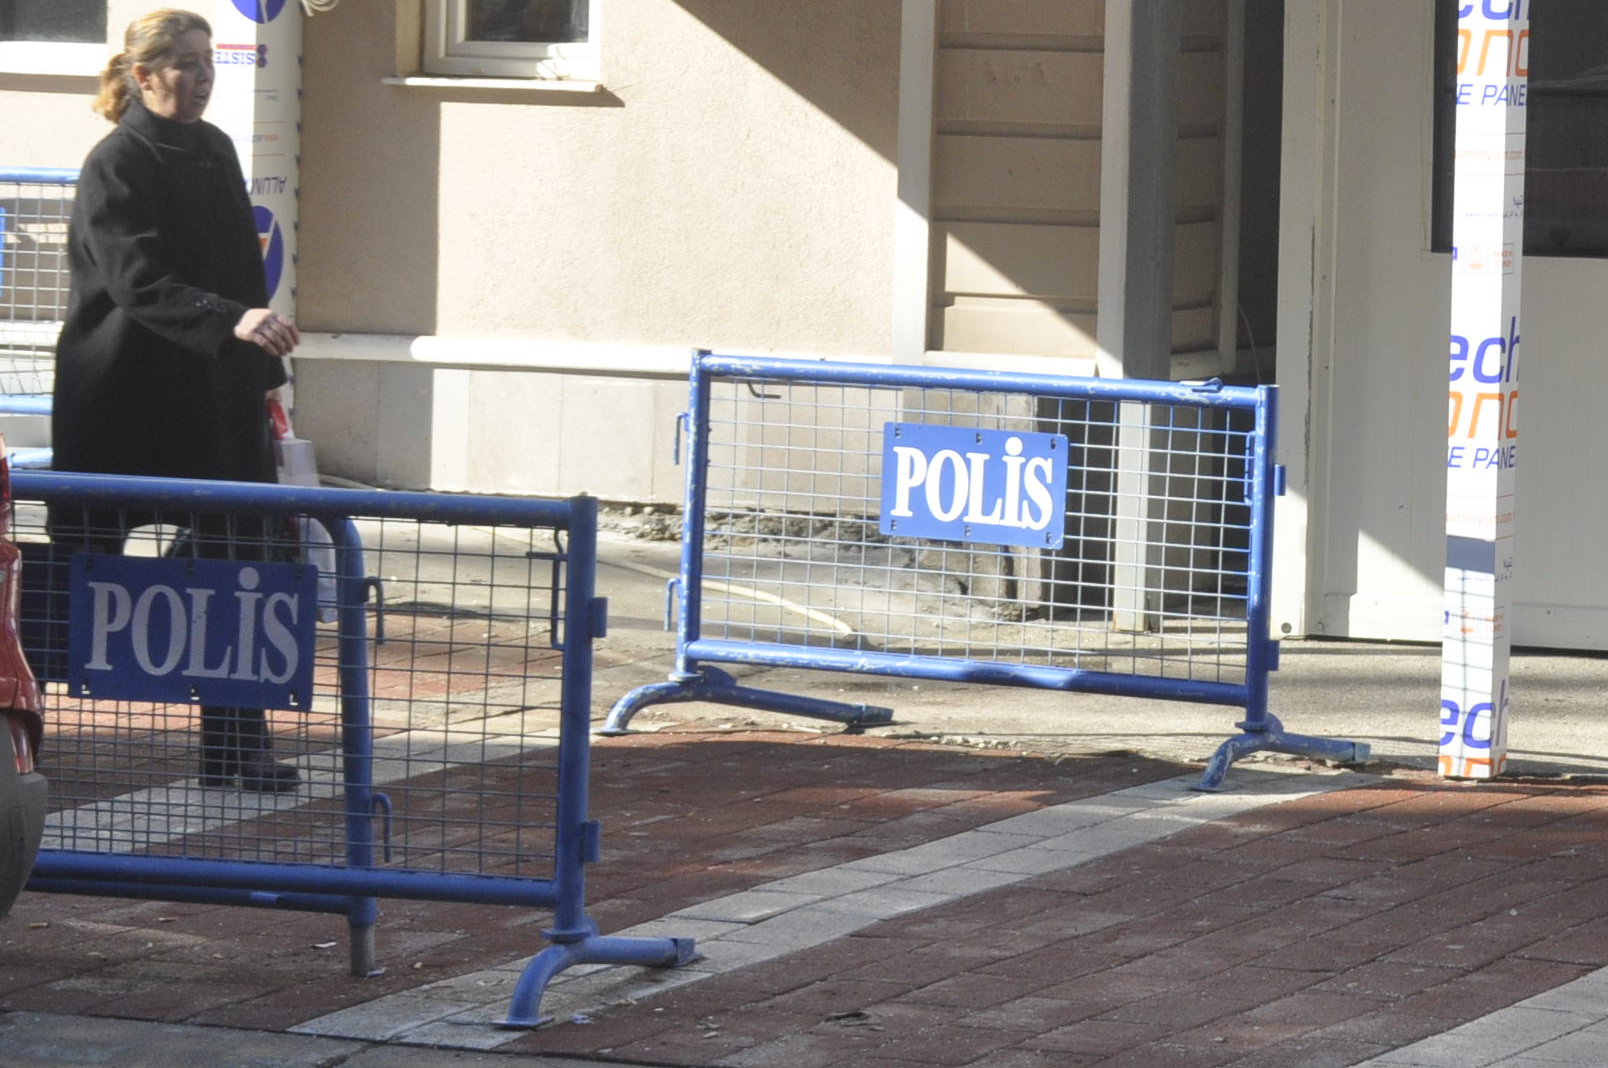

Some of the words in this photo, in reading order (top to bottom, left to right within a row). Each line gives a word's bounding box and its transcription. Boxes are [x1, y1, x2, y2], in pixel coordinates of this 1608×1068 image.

[1481, 83, 1527, 107] PANE
[890, 436, 1054, 531] POLİS
[1472, 445, 1517, 470] PANE
[84, 566, 299, 684] POLİS
